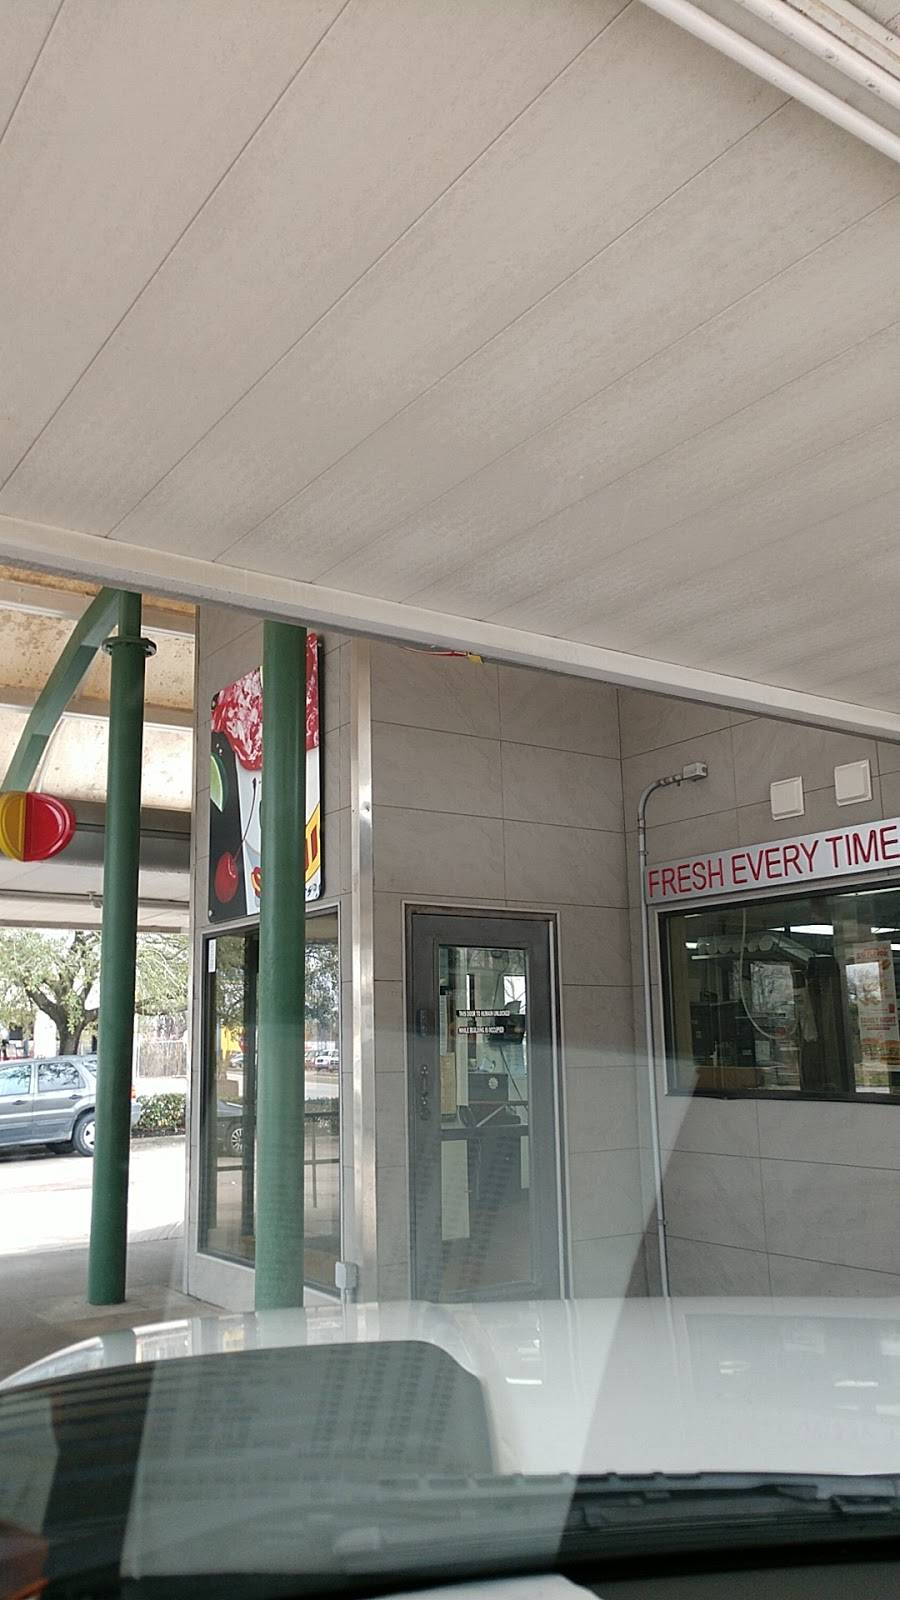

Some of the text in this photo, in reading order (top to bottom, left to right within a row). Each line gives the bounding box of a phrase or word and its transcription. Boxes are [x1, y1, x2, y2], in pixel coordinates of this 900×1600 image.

[648, 825, 900, 898] FRESH EVERY TIME
